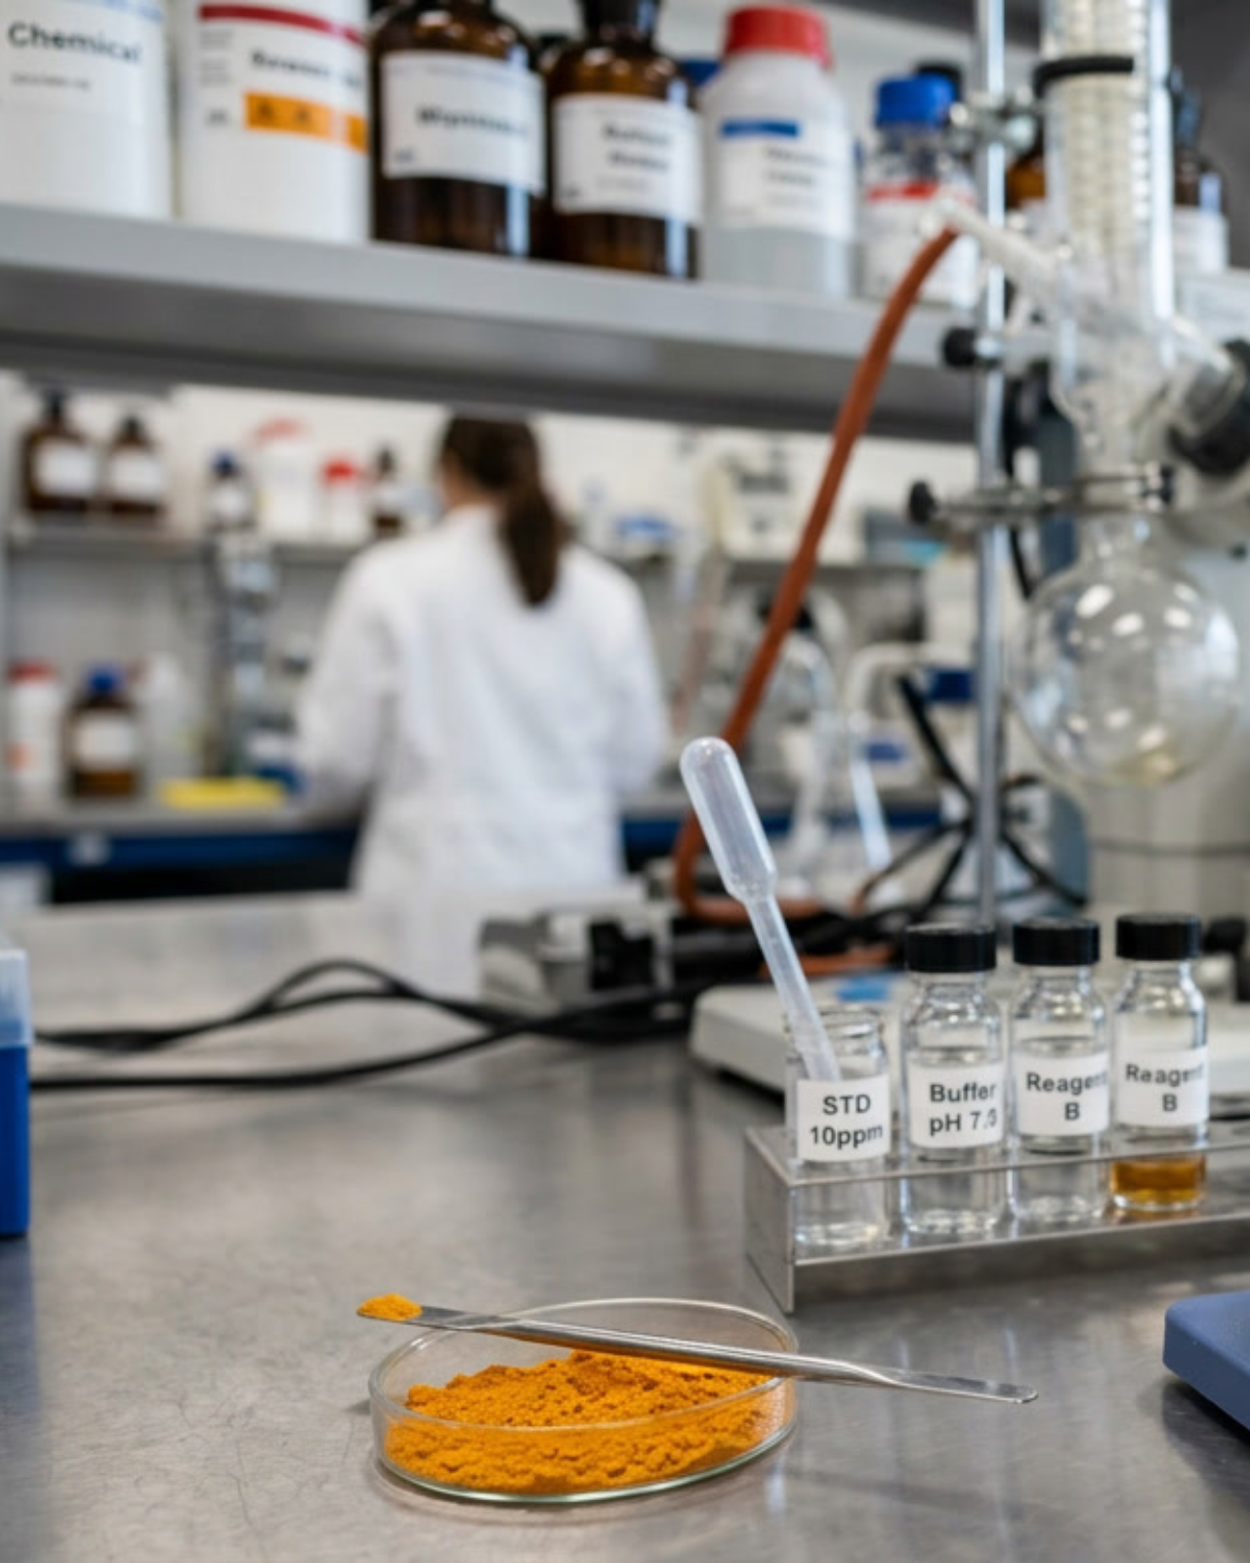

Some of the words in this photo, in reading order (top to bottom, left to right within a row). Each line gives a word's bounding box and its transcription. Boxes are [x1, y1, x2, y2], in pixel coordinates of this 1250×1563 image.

[1125, 1063, 1204, 1088] Reag
[930, 1082, 997, 1103] Buffer
[1161, 1093, 1178, 1113] B
[822, 1094, 871, 1116] STD
[1064, 1102, 1081, 1122] B
[929, 1113, 962, 1137] pH
[810, 1125, 883, 1150] 10ppm
